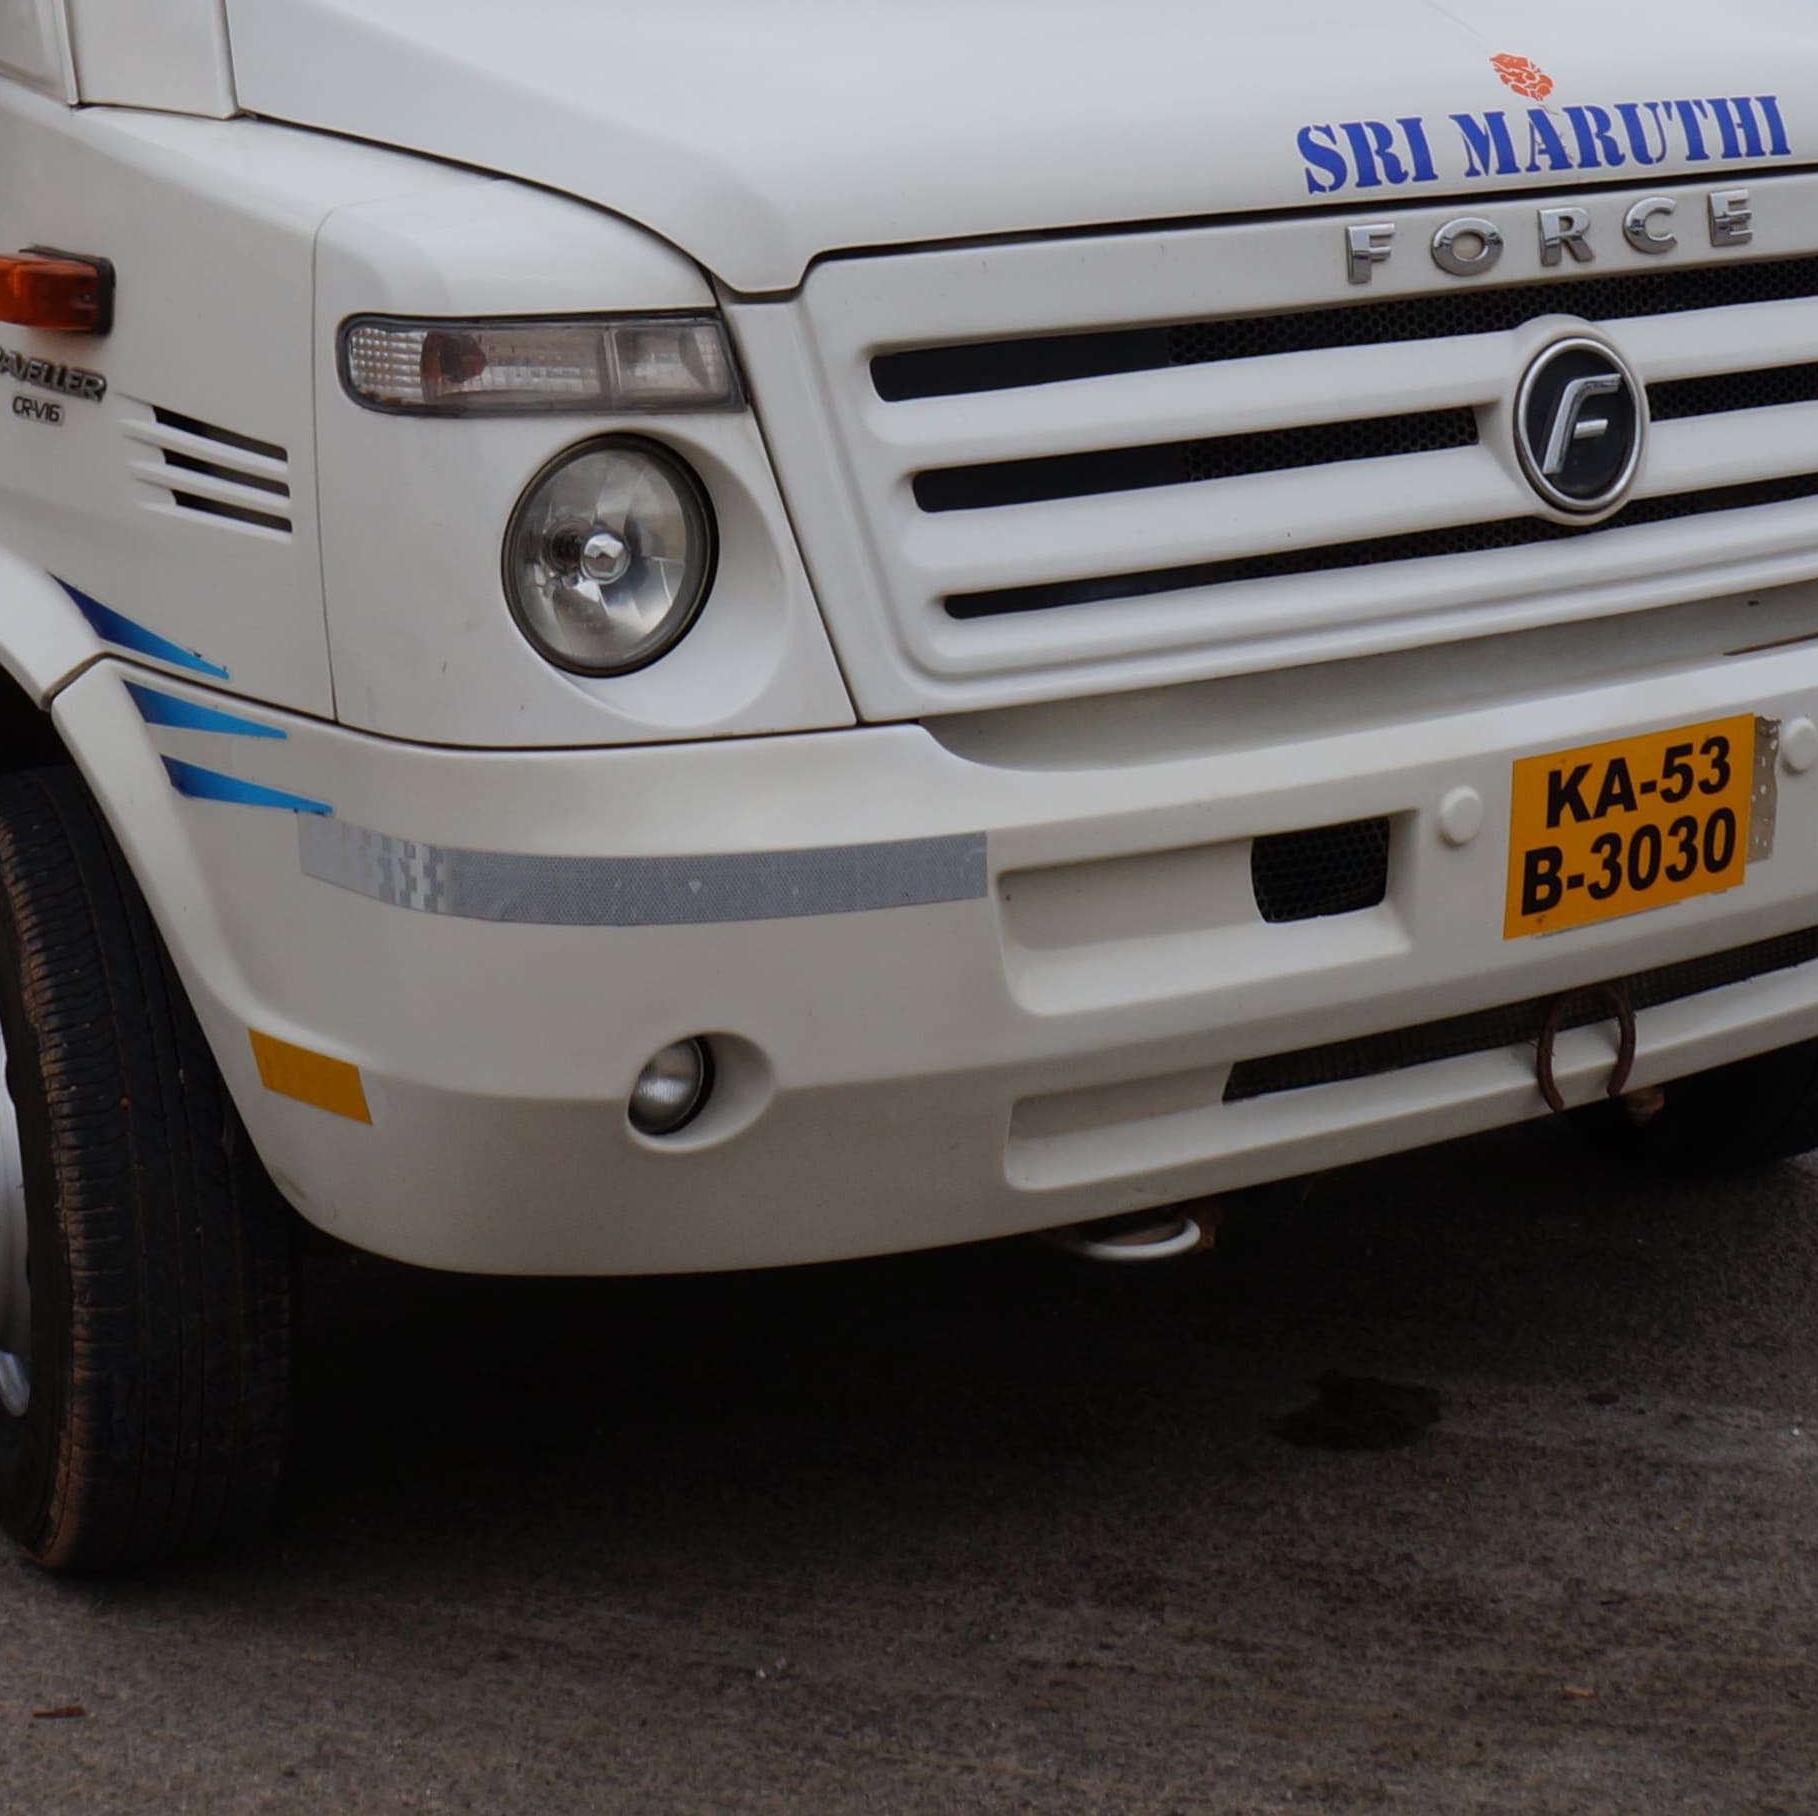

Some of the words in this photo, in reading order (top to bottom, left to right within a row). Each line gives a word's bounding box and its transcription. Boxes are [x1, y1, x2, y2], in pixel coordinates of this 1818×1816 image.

[1296, 116, 1439, 194] SRI
[1449, 95, 1791, 177] MARUTHI
[1345, 188, 1754, 285] FORCE
[1545, 735, 1732, 829] KA-53
[1521, 806, 1737, 917] B-3030
